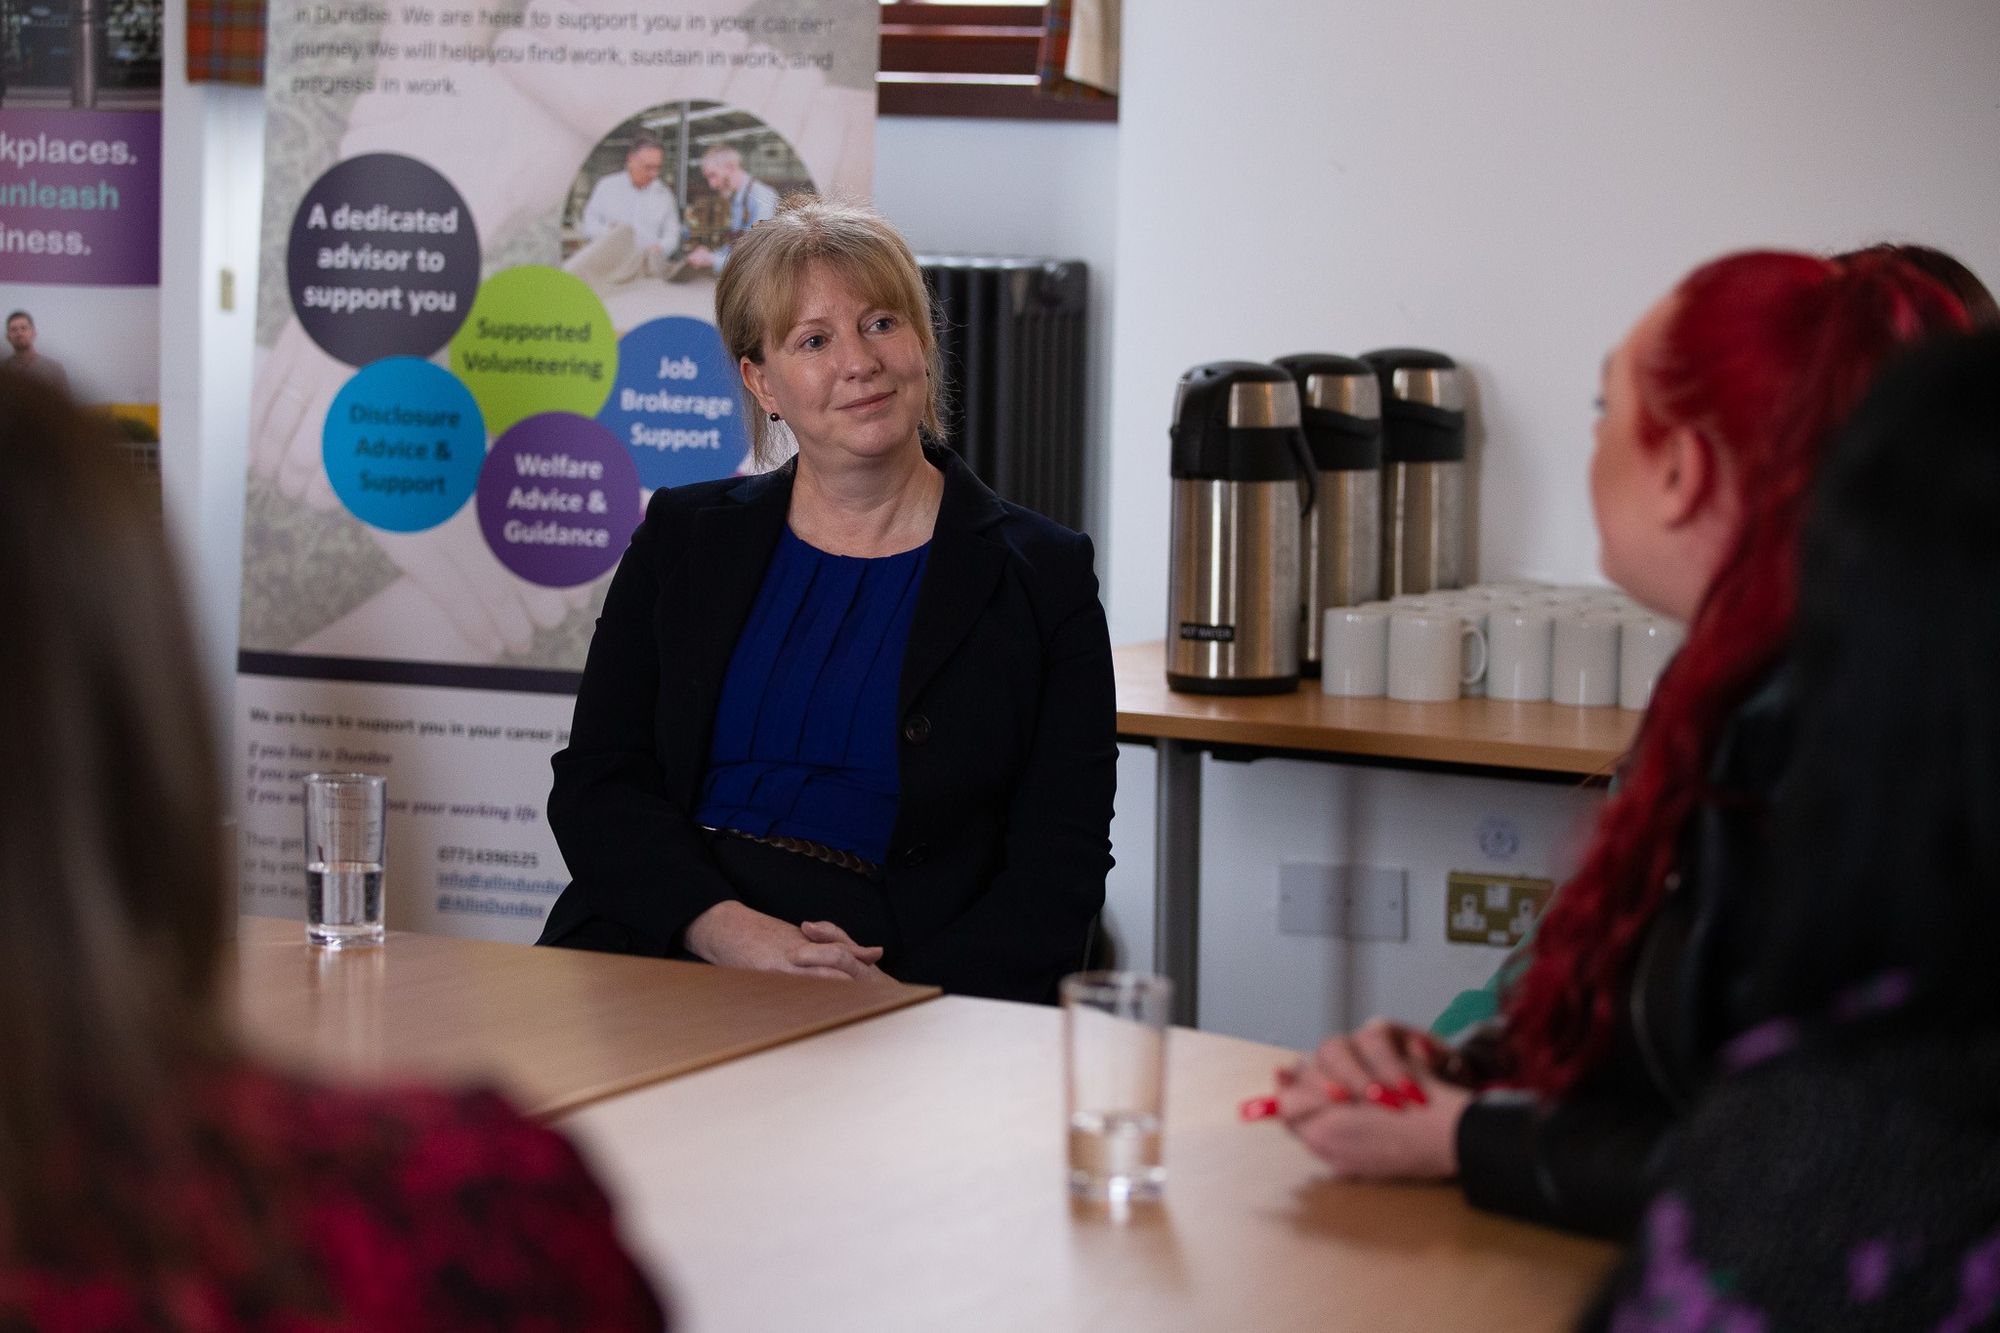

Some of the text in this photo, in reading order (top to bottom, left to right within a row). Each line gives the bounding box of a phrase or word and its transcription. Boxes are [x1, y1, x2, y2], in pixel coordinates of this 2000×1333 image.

[403, 7, 433, 25] We
[439, 11, 472, 27] are
[479, 9, 524, 26] here
[529, 10, 551, 28] to
[557, 13, 638, 32] support
[643, 16, 681, 35] you
[686, 14, 706, 31] in
[711, 16, 756, 36] your
[762, 16, 834, 33] career
[366, 41, 398, 60] We
[404, 41, 436, 60] will
[442, 42, 489, 64] help
[528, 43, 567, 63] find
[630, 47, 703, 67] sustain
[706, 48, 726, 66] in
[791, 53, 834, 72] and
[291, 76, 376, 96] progress
[381, 76, 400, 93] in
[306, 203, 458, 233] A dedicated
[316, 242, 446, 272] advisor to
[303, 286, 456, 316] support you
[477, 318, 591, 343] Supported
[463, 352, 603, 381] Volunteering
[658, 355, 699, 380] Job
[351, 403, 461, 429] Disclosure
[620, 388, 734, 420] Brokerage
[356, 436, 451, 461] Advice &
[630, 421, 721, 451] Support
[515, 453, 603, 480] Welfare
[359, 472, 447, 496] Support
[507, 486, 608, 514] Advice &
[503, 519, 609, 548] Guidance
[273, 710, 296, 724] are
[300, 710, 333, 727] here
[336, 713, 353, 729] to
[357, 715, 415, 735] support
[419, 719, 446, 737] you
[450, 722, 464, 737] in
[468, 724, 501, 742] your
[506, 728, 552, 743] career
[412, 801, 445, 817] your
[449, 802, 512, 824] working
